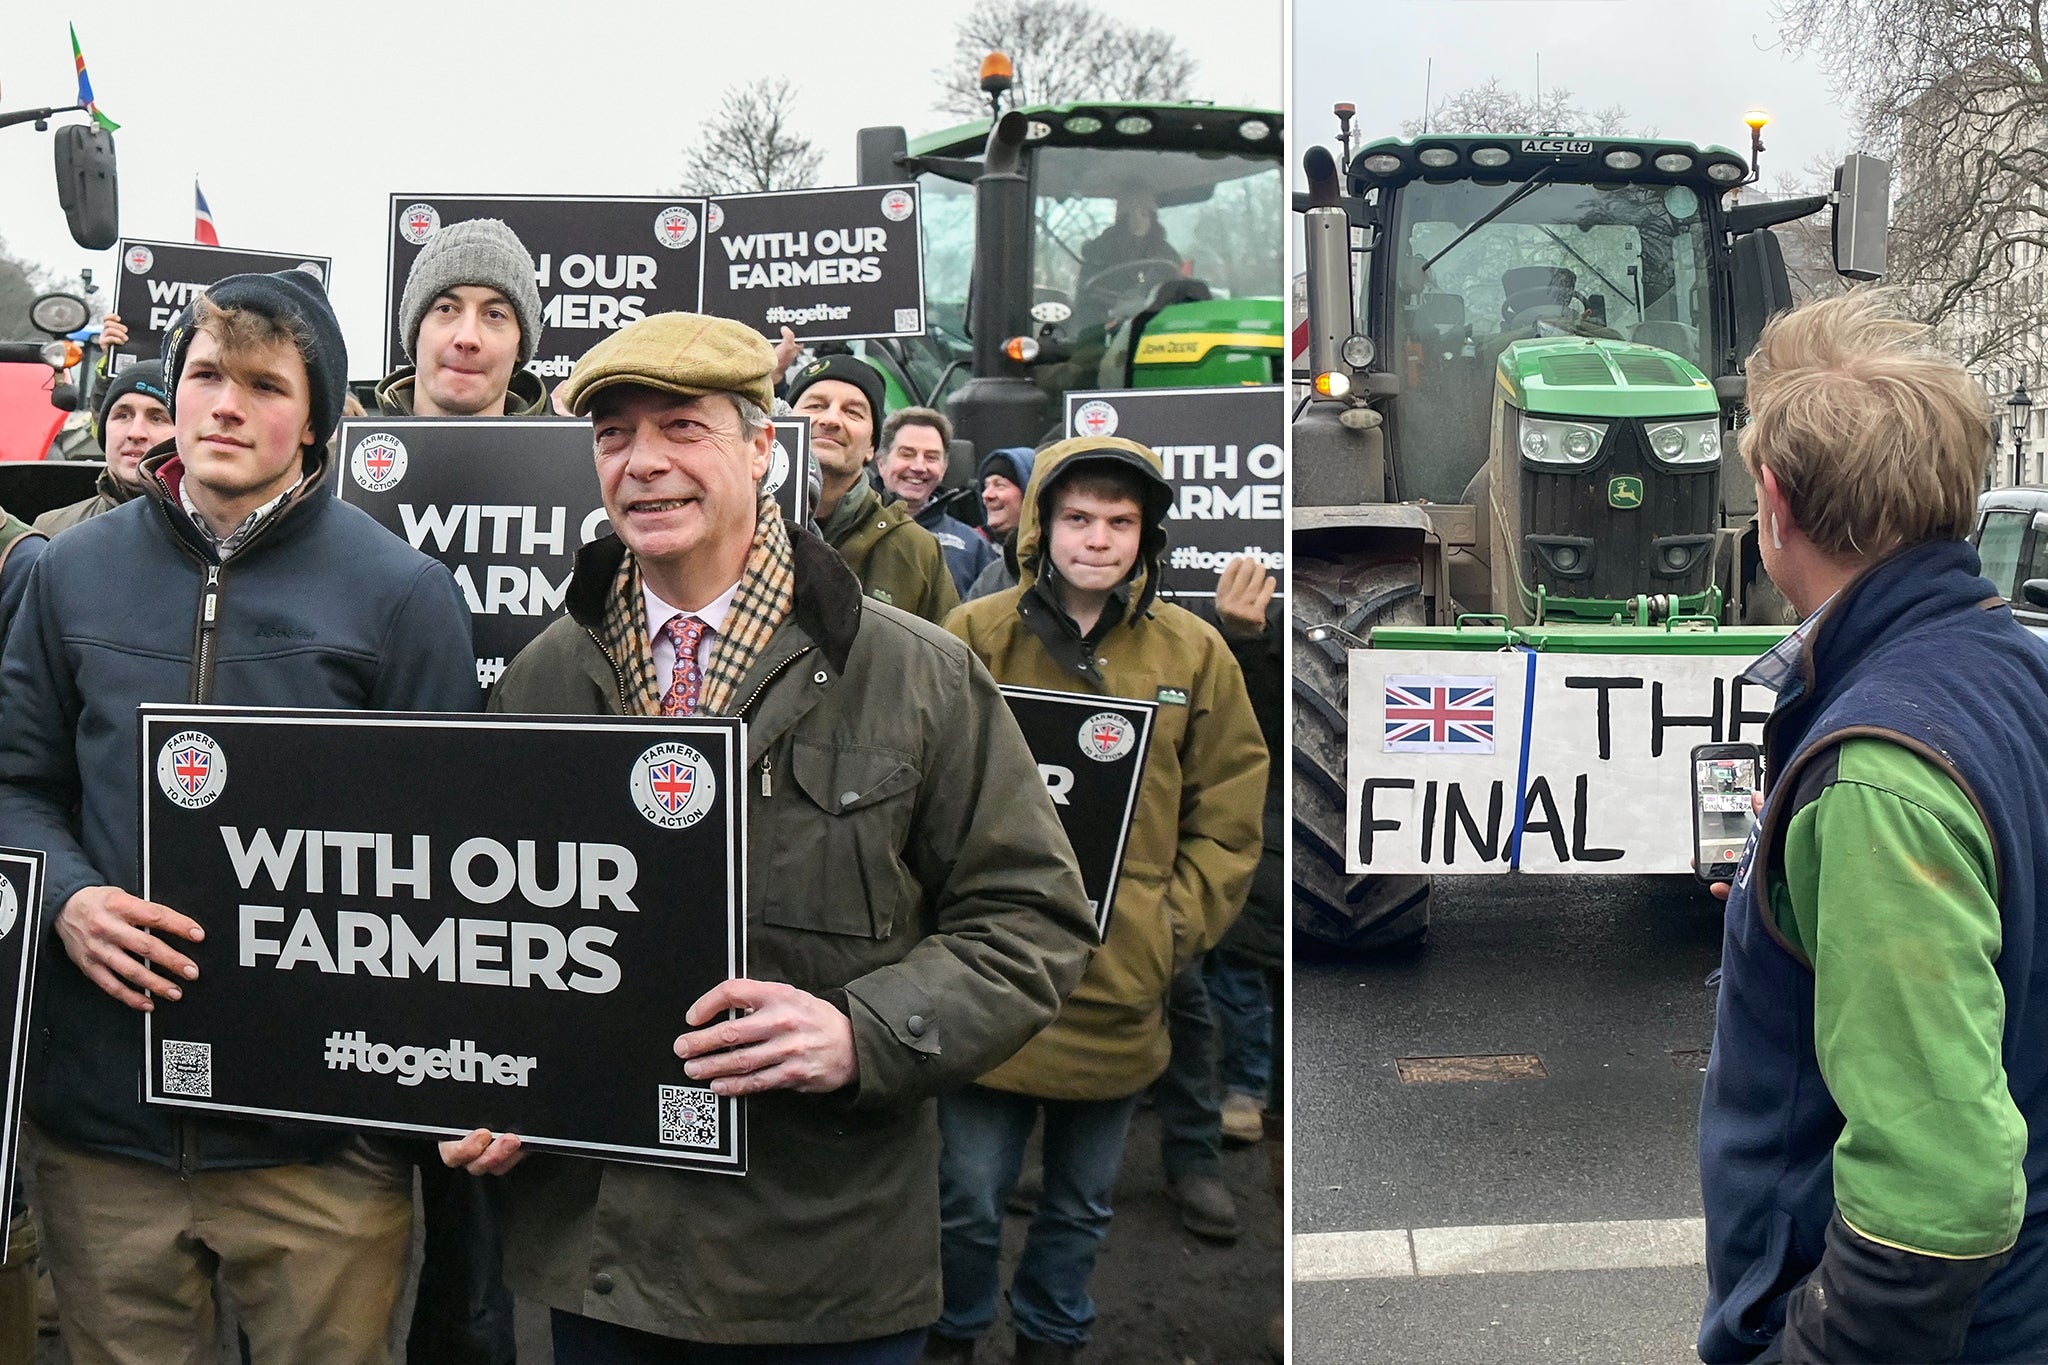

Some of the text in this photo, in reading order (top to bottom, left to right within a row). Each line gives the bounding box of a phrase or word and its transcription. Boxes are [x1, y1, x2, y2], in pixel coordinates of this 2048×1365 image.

[1566, 142, 1590, 153] Ltd
[720, 227, 888, 261] WITH OUR
[559, 253, 658, 290] OUR
[729, 256, 883, 290] FARMERS
[147, 279, 212, 306] WIT
[765, 303, 852, 326] #together
[361, 434, 400, 449] FARMERS
[1151, 445, 1238, 480] ITH
[357, 475, 399, 491] TO ACTION
[397, 503, 567, 556] WITH
[1090, 714, 1129, 726] FARMERS
[167, 732, 216, 751] FARMERS
[641, 744, 702, 765] FARMERS
[166, 785, 218, 807] TO ACTION
[641, 803, 704, 827] TO ACTION
[1358, 773, 1626, 866] FINAL
[219, 825, 640, 913] WITH OUR
[238, 904, 622, 994] FARMERS
[324, 1030, 537, 1088] #together
